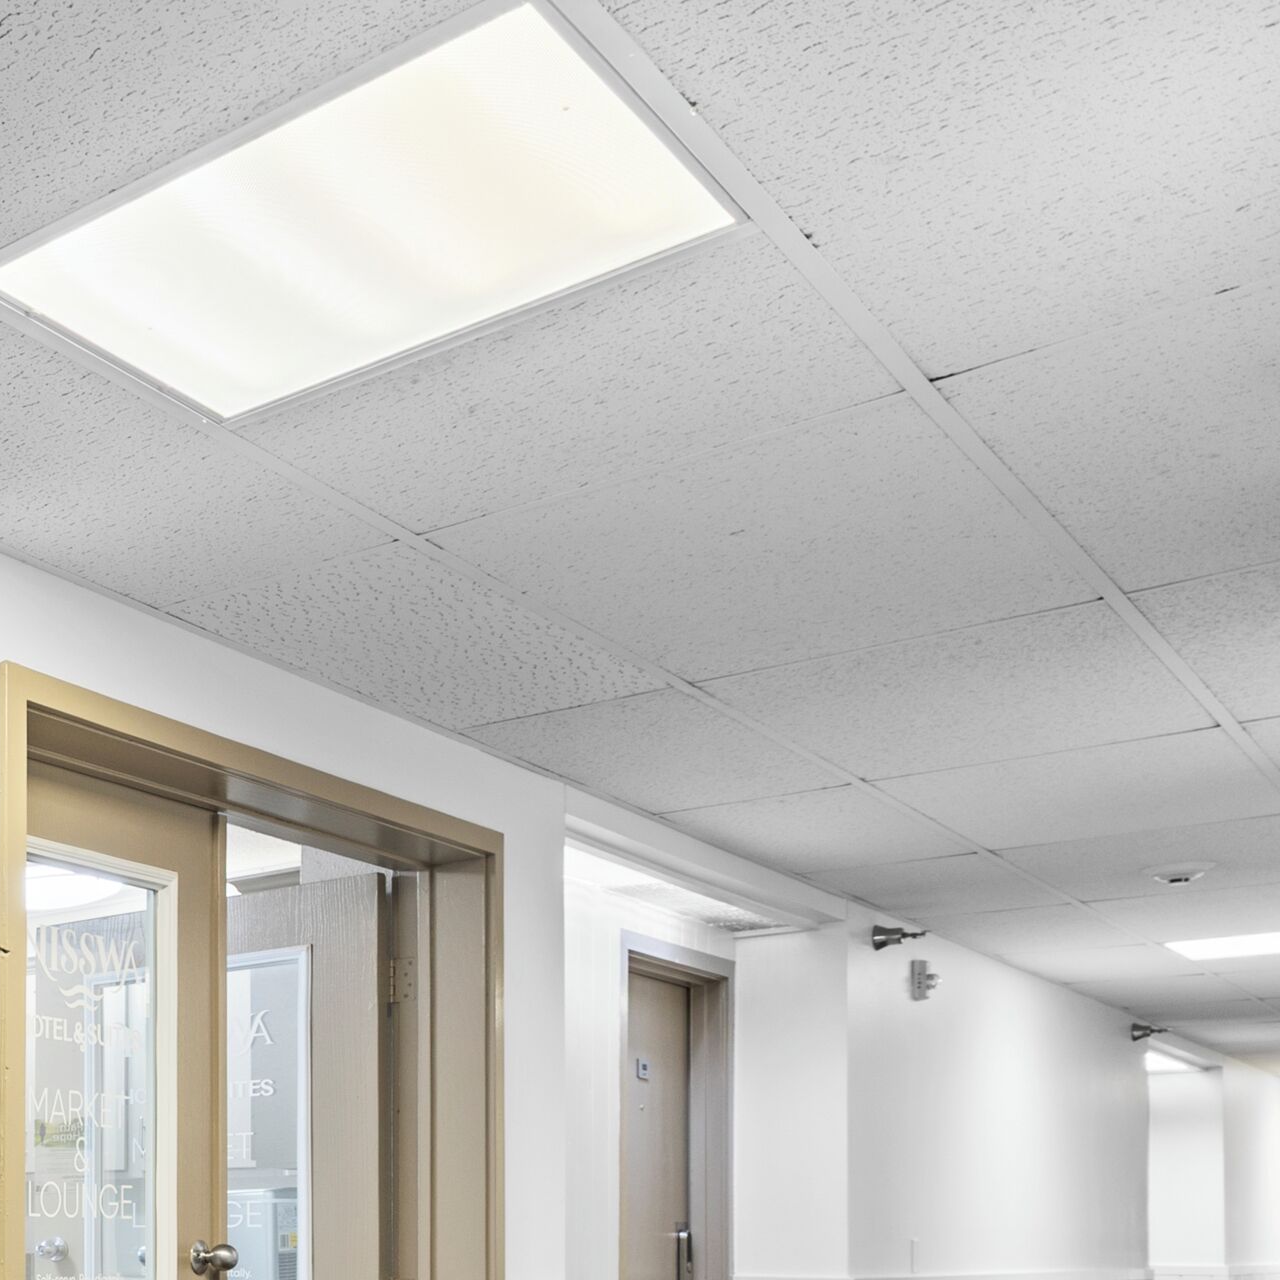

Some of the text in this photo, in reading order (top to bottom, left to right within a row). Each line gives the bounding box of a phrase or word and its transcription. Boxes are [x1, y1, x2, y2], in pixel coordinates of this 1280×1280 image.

[33, 1014, 73, 1042] OTEL
[229, 1079, 275, 1097] ITES
[28, 1086, 128, 1128] MARKET
[74, 1137, 89, 1172] &
[28, 1181, 133, 1219] LOUNGE
